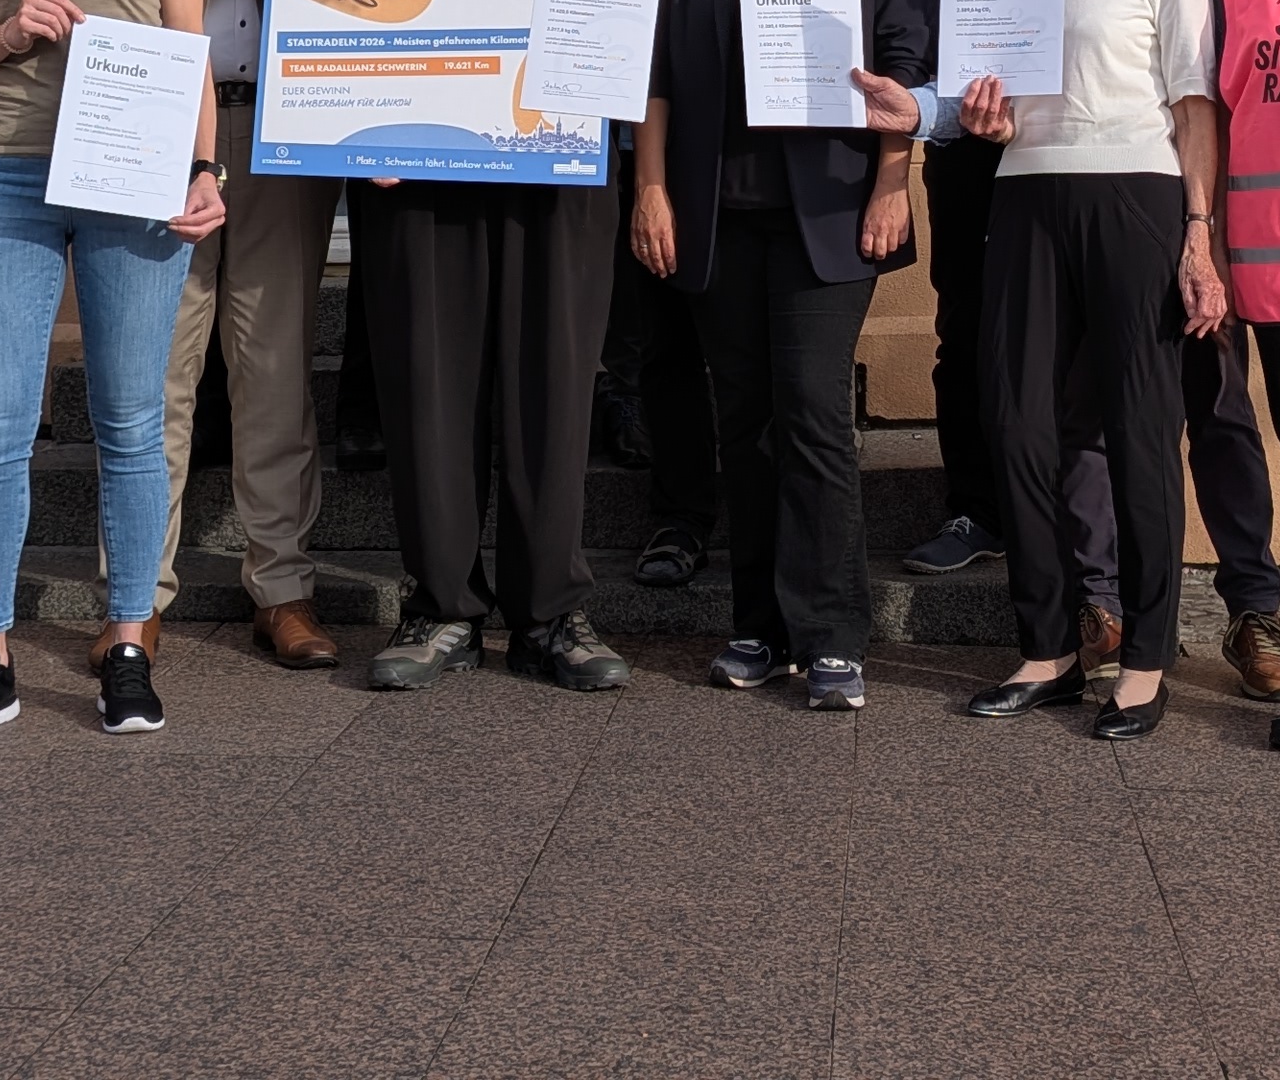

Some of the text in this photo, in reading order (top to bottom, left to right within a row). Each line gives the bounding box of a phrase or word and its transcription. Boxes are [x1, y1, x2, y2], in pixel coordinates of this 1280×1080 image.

[286, 37, 358, 47] STADTRADELN
[359, 37, 386, 46] 2026
[393, 36, 431, 46] Meisten
[433, 35, 488, 48] gefahrenen
[85, 56, 149, 79] Urkunde
[289, 62, 427, 73] TEAM RADALLIANZ SCHWERIN
[443, 61, 490, 70] 19.621 Km
[282, 86, 351, 96] EUER GEWINN
[281, 97, 412, 108] EIN AMBERBAUM FÜR LANKOW
[104, 154, 121, 163] Katja
[346, 155, 354, 165] 1.
[355, 156, 377, 166] Platz
[384, 157, 423, 167] Schwerin
[424, 158, 447, 168] fährt.
[449, 159, 481, 169] Lankow
[483, 159, 515, 171] wächst.
